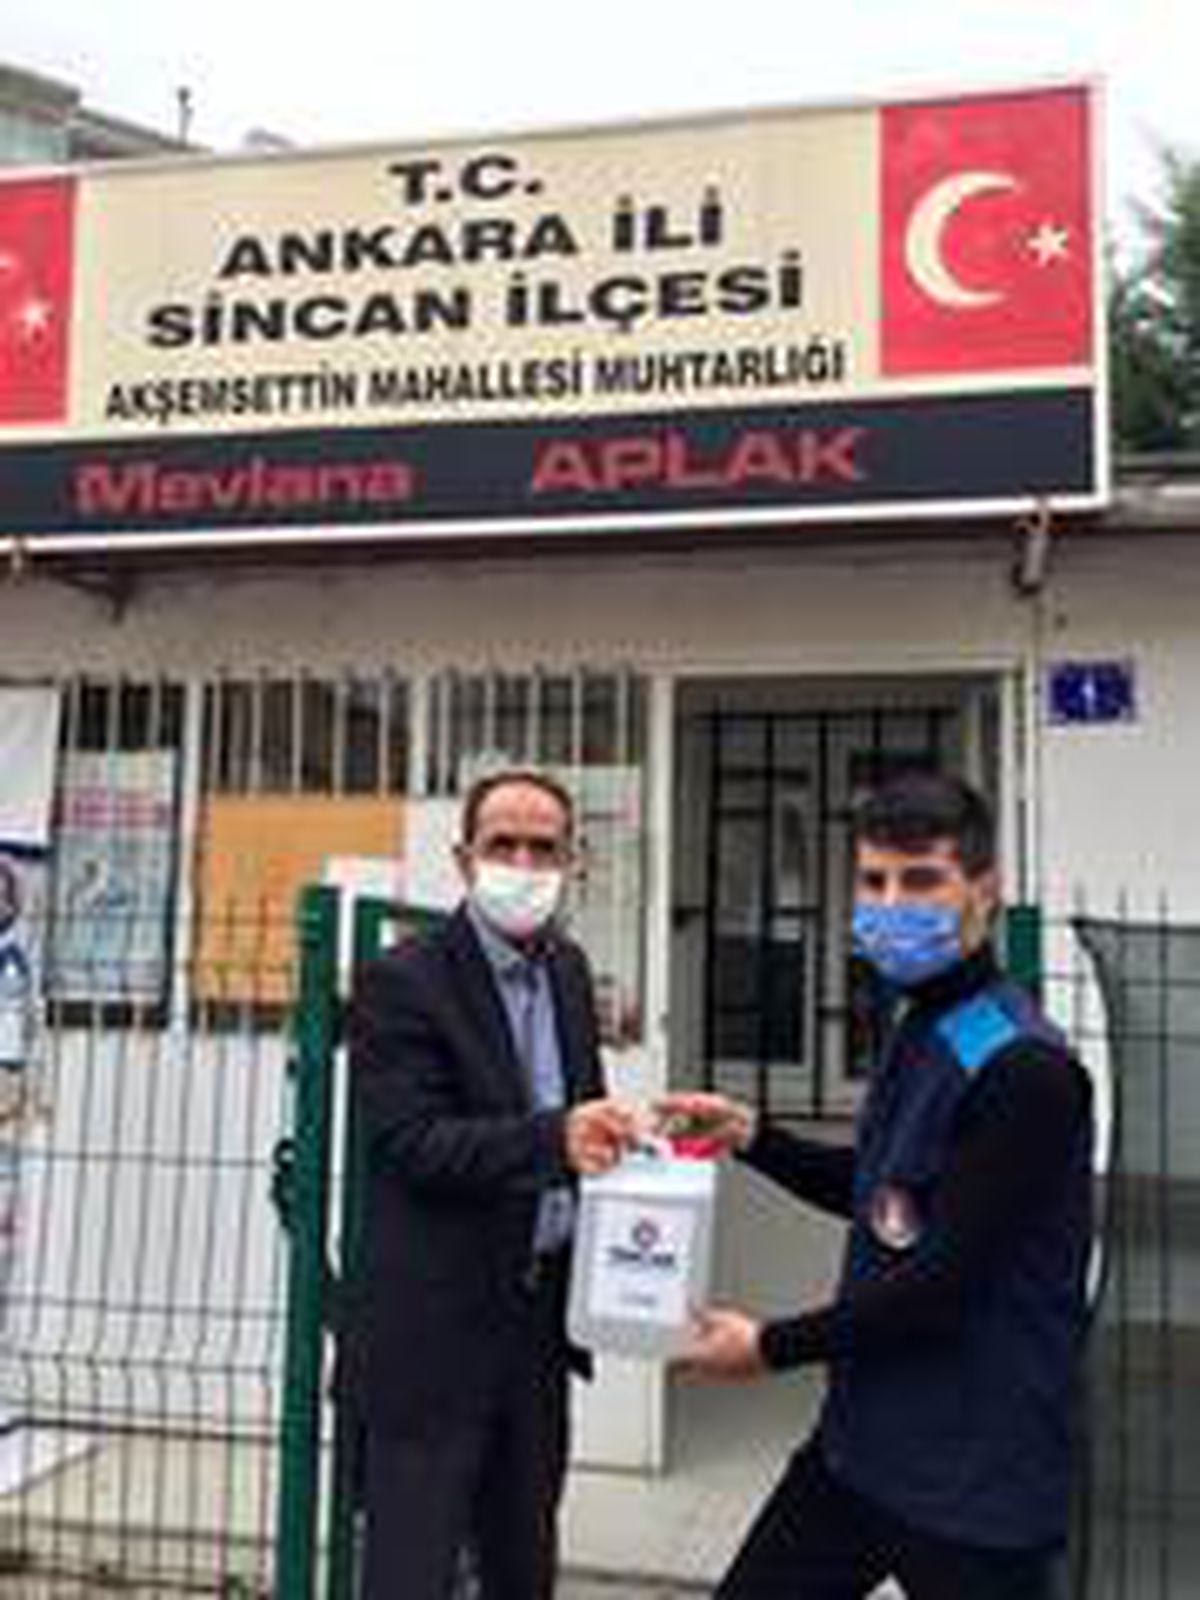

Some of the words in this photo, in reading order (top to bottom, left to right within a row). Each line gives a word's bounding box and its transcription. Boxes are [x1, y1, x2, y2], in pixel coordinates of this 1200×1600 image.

[389, 154, 544, 202] T.C.
[219, 214, 579, 279] ANKARA
[612, 188, 723, 252] İLİ
[147, 291, 471, 349] SİNCAN
[507, 251, 803, 333] İLÇESİ
[106, 361, 356, 423] AKŞEMSETTİN
[367, 348, 584, 403] MAHALLESİ
[594, 339, 847, 397] MUHTARLIĞI
[531, 427, 868, 493] APLAK
